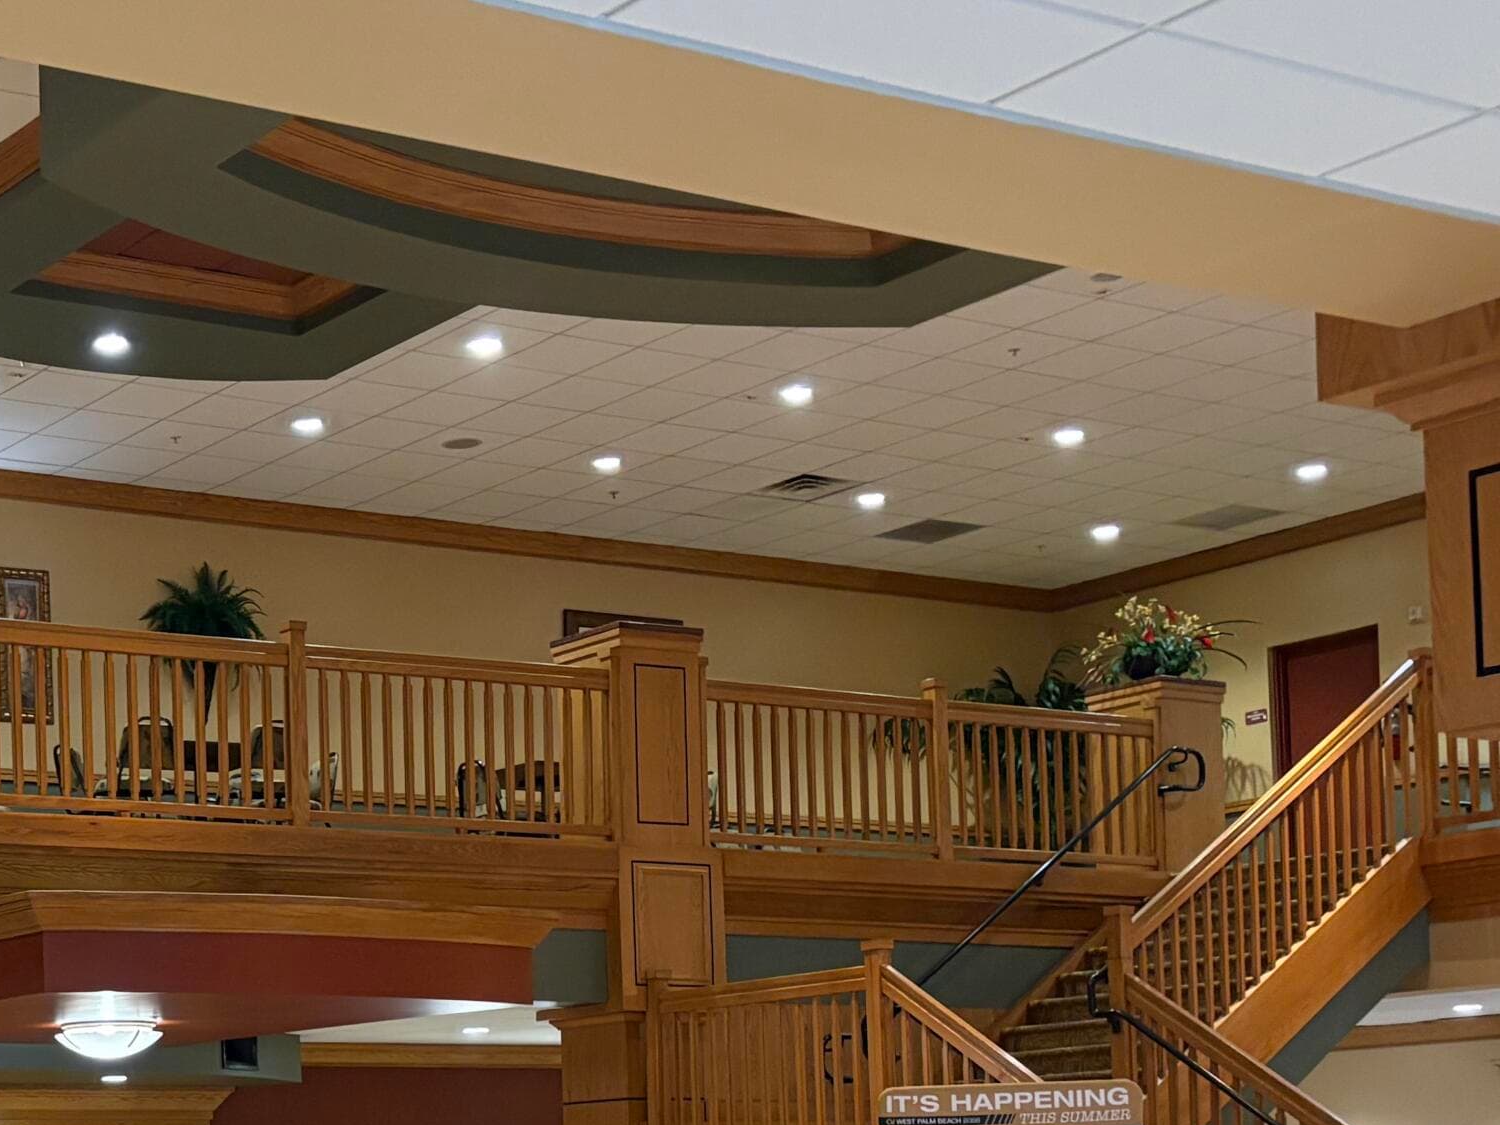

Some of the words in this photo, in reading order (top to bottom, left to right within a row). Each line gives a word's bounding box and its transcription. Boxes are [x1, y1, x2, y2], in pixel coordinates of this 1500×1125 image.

[886, 1094, 940, 1113] IT'S
[950, 1087, 1130, 1112] HAPPENING
[896, 1118, 916, 1125] WEST
[937, 1117, 962, 1125] BEACH
[1020, 1112, 1056, 1125] THIS
[1060, 1108, 1132, 1123] SUMMER
